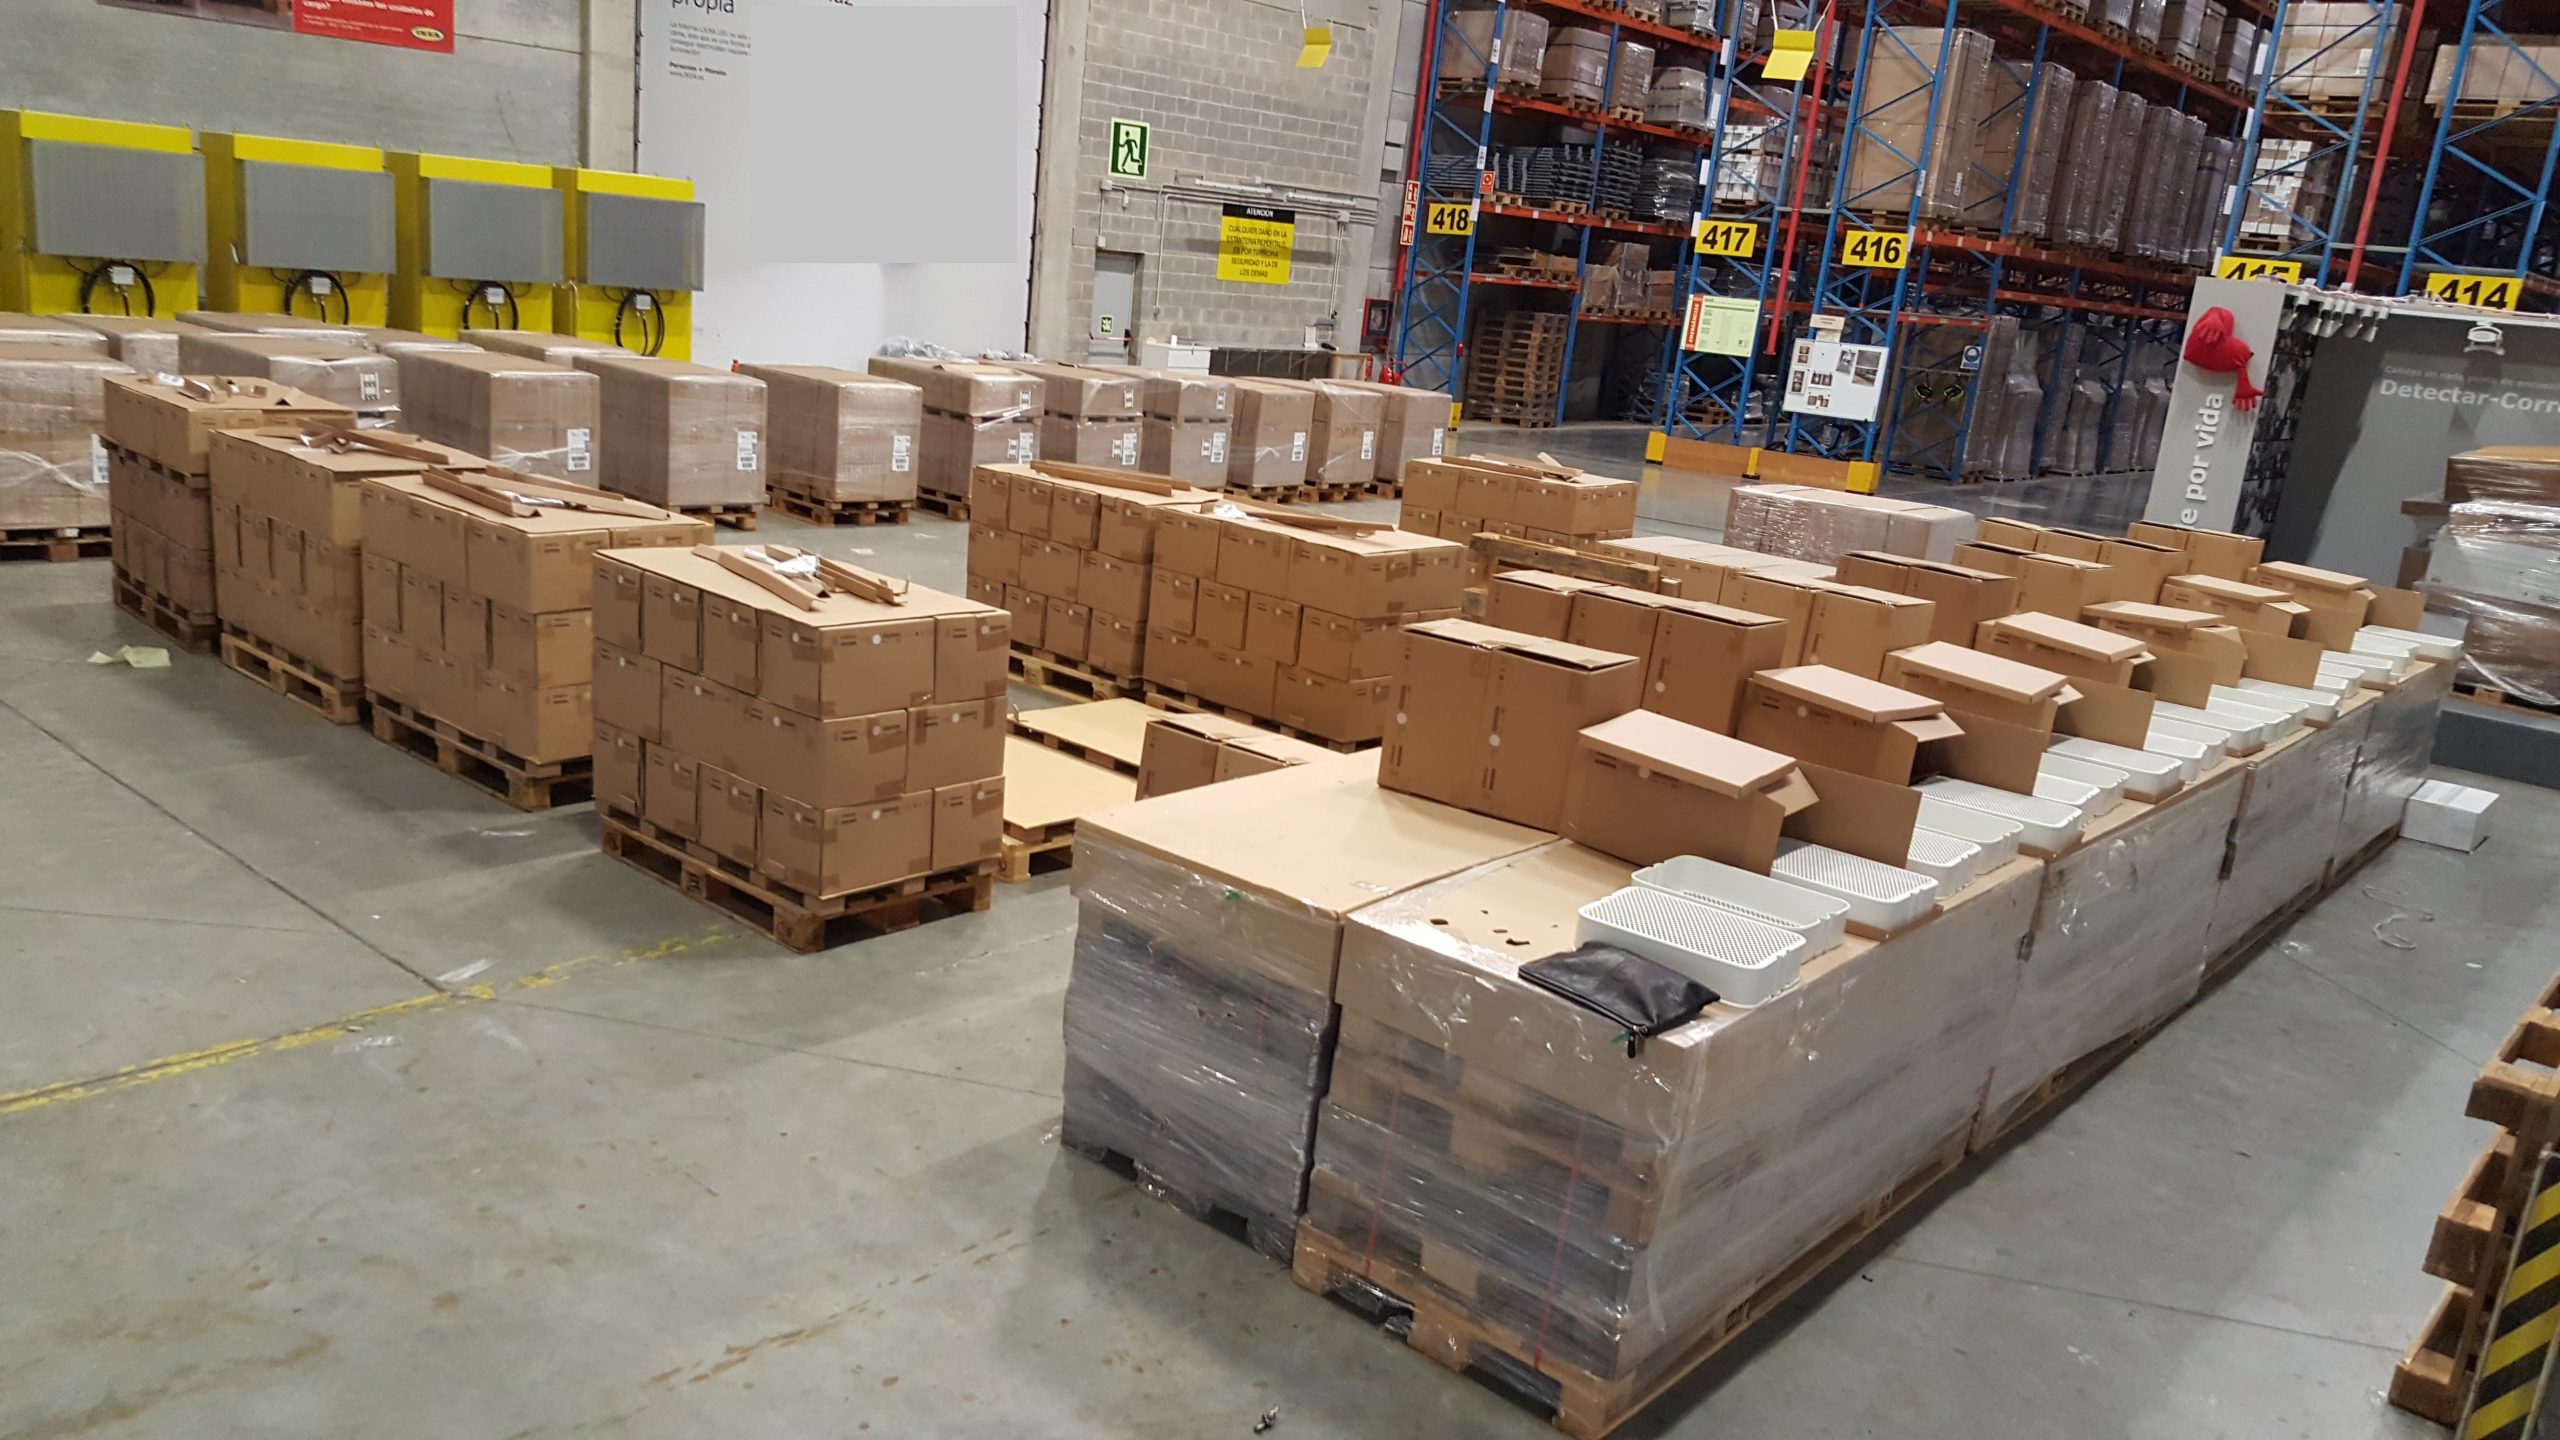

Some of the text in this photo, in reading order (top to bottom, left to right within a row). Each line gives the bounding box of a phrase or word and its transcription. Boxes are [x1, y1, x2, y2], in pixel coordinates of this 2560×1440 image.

[1433, 207, 1469, 231] 418
[1281, 230, 1287, 238] LA
[1702, 225, 1750, 253] 417
[1850, 235, 1902, 264] 416
[2438, 279, 2509, 308] 414
[2379, 378, 2560, 414] Detectar-Corr
[2194, 393, 2225, 448] vida
[2185, 455, 2210, 501] por
